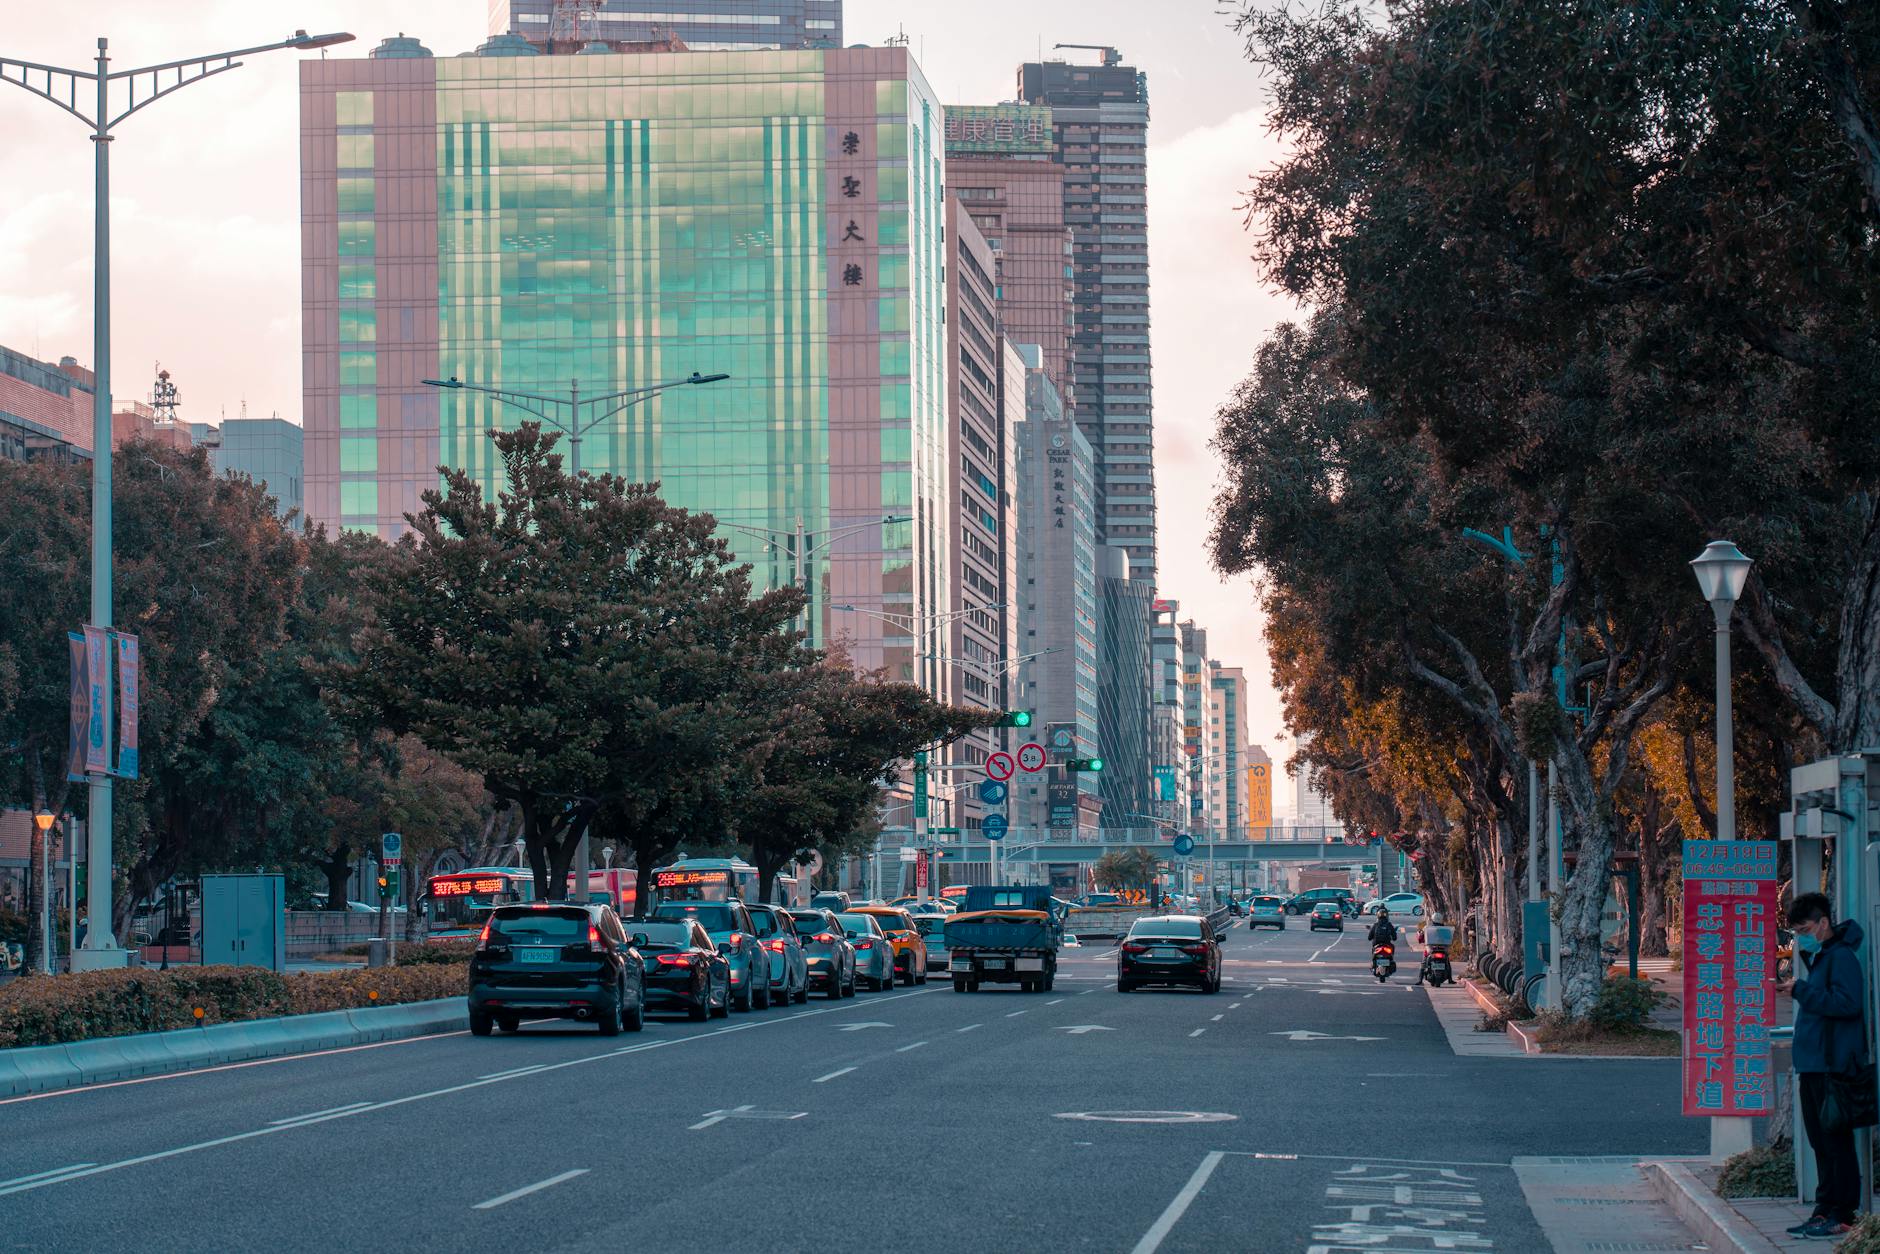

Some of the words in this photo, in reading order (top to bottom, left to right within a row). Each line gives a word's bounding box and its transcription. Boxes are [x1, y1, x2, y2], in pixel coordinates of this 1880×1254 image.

[841, 131, 864, 286] 崇聖大樓
[1695, 902, 1724, 1110] 忠孝東路地下道
